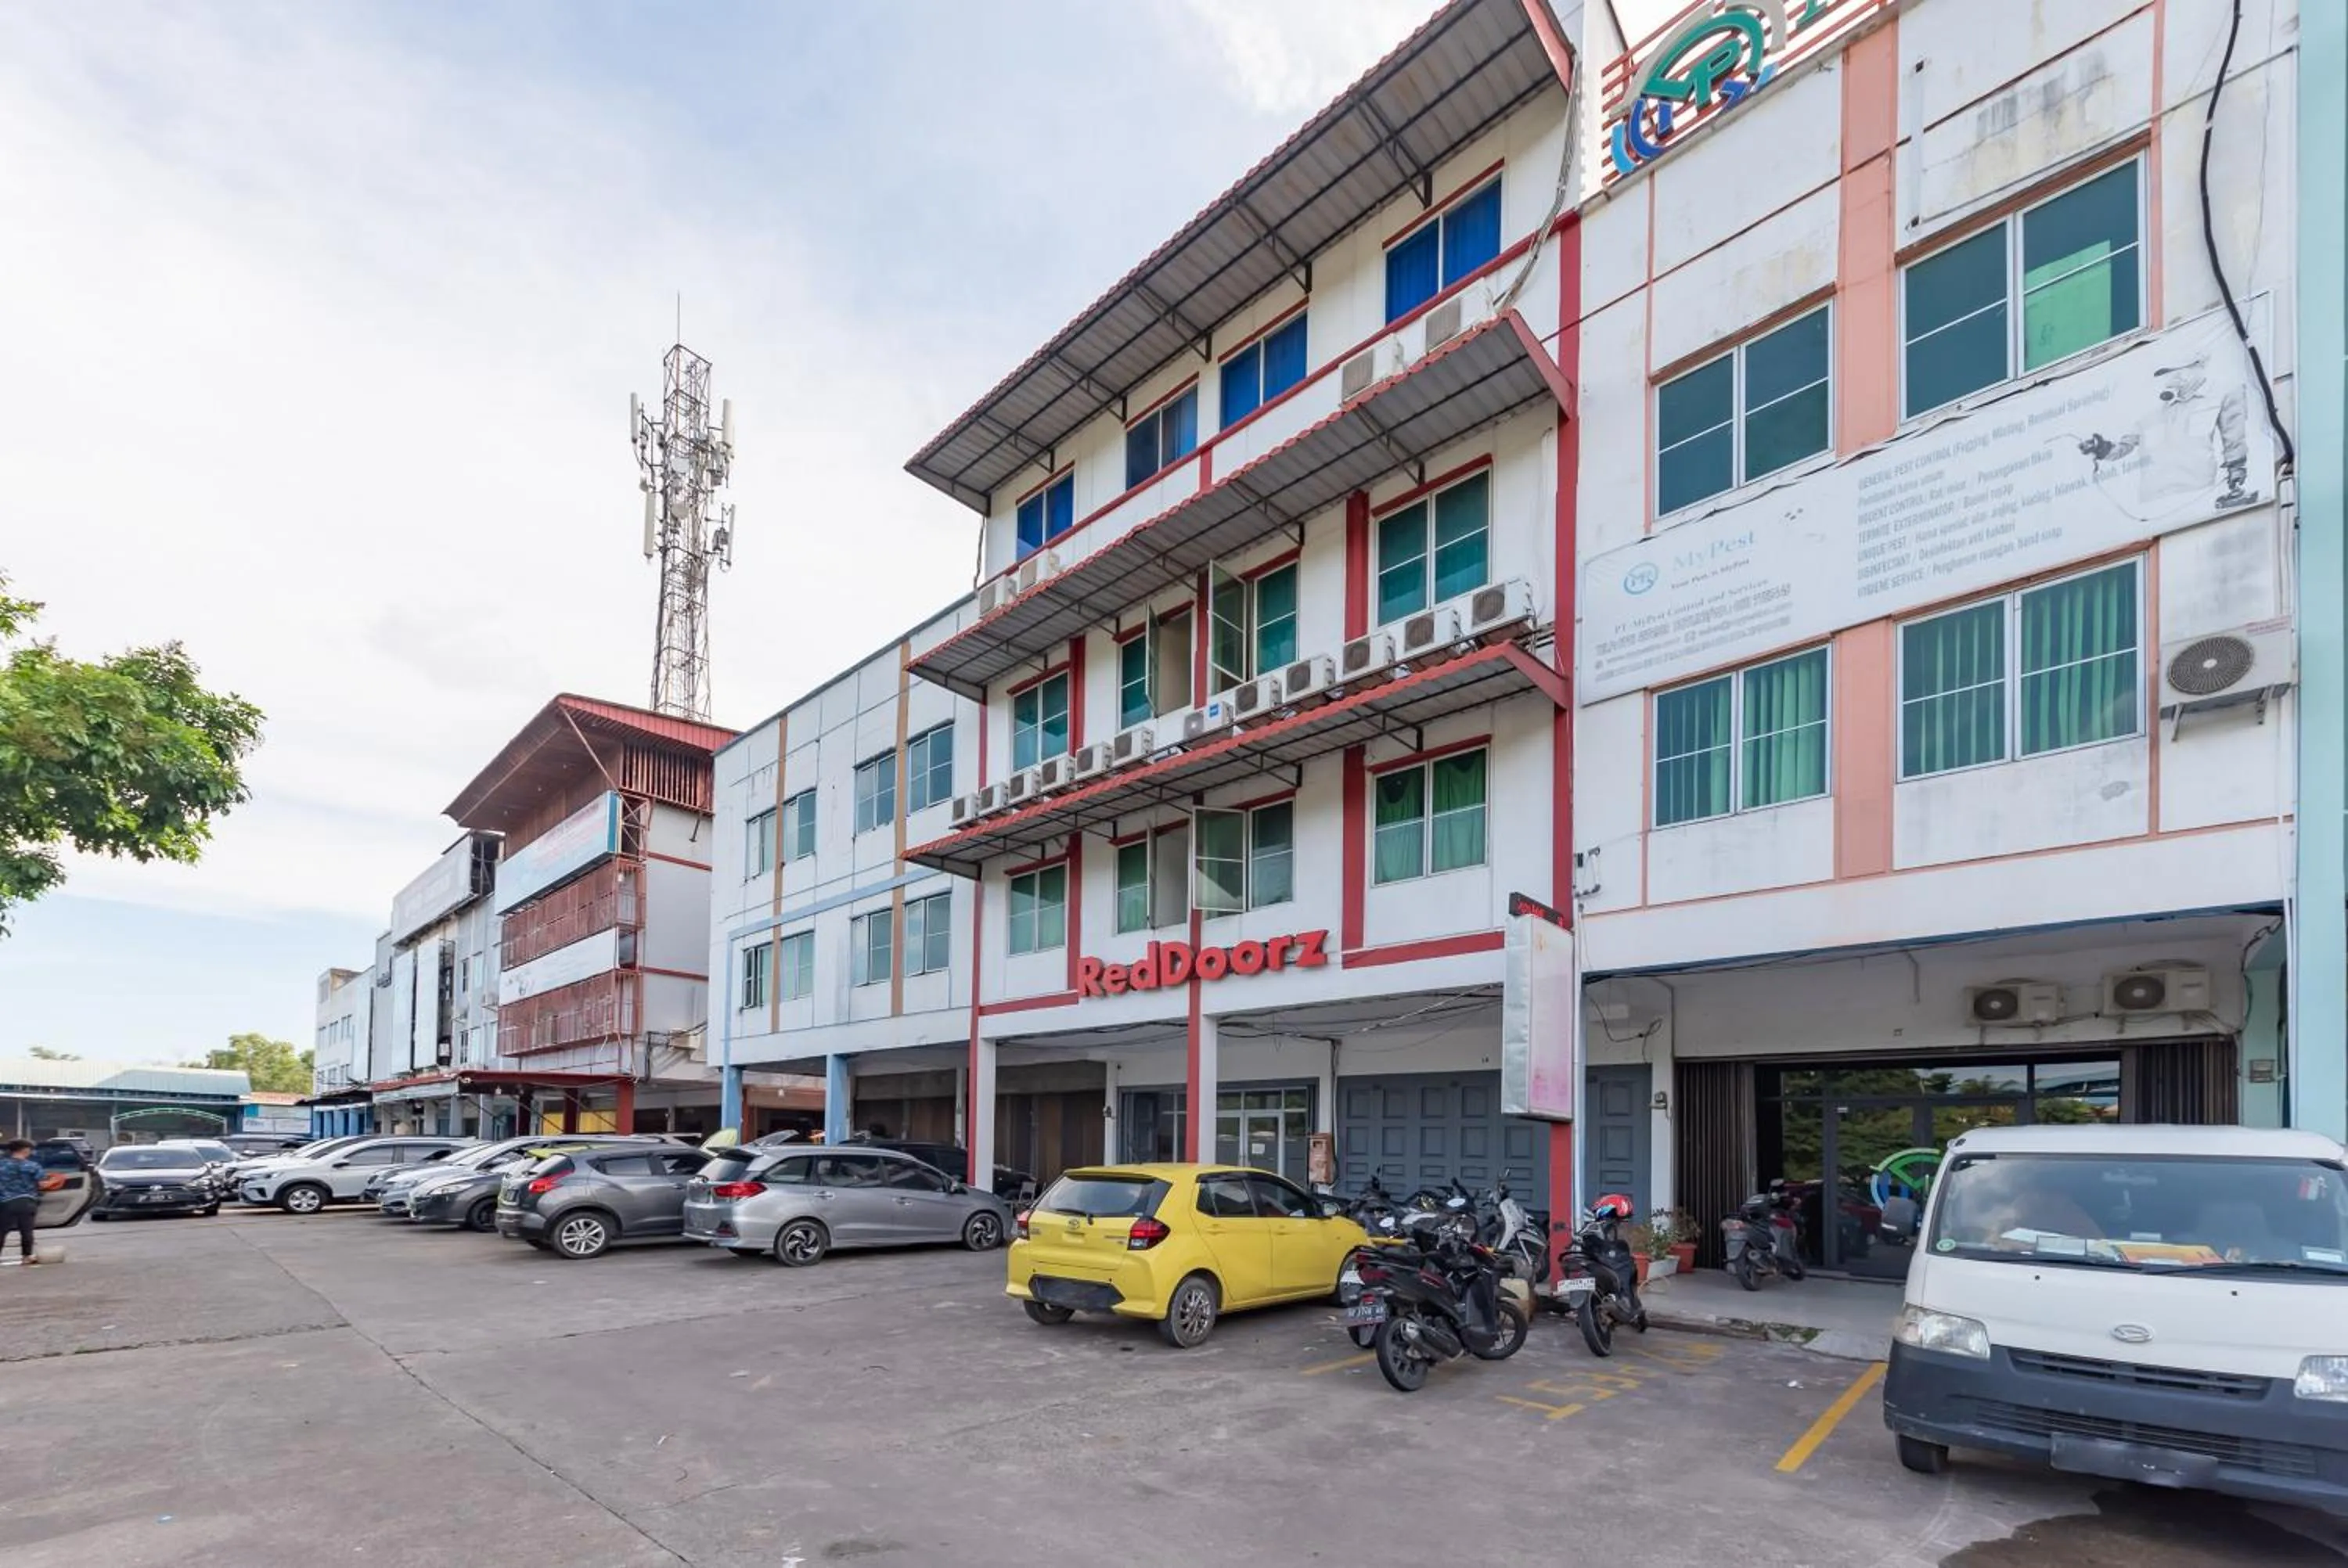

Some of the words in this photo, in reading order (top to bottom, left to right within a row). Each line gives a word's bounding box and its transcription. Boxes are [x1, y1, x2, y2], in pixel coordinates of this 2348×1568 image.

[1894, 461, 1914, 477] PEST
[1914, 446, 1950, 469] CONTROL
[1889, 494, 1924, 515] CONTROL
[1894, 501, 1954, 532] EXTERMINATOR
[1672, 530, 1756, 570] MyPest
[1888, 535, 1907, 550] PEST
[1857, 552, 1910, 581] DISINFECTANT
[1891, 567, 1924, 588] SERVICE
[1077, 929, 1329, 998] RedDoorz
